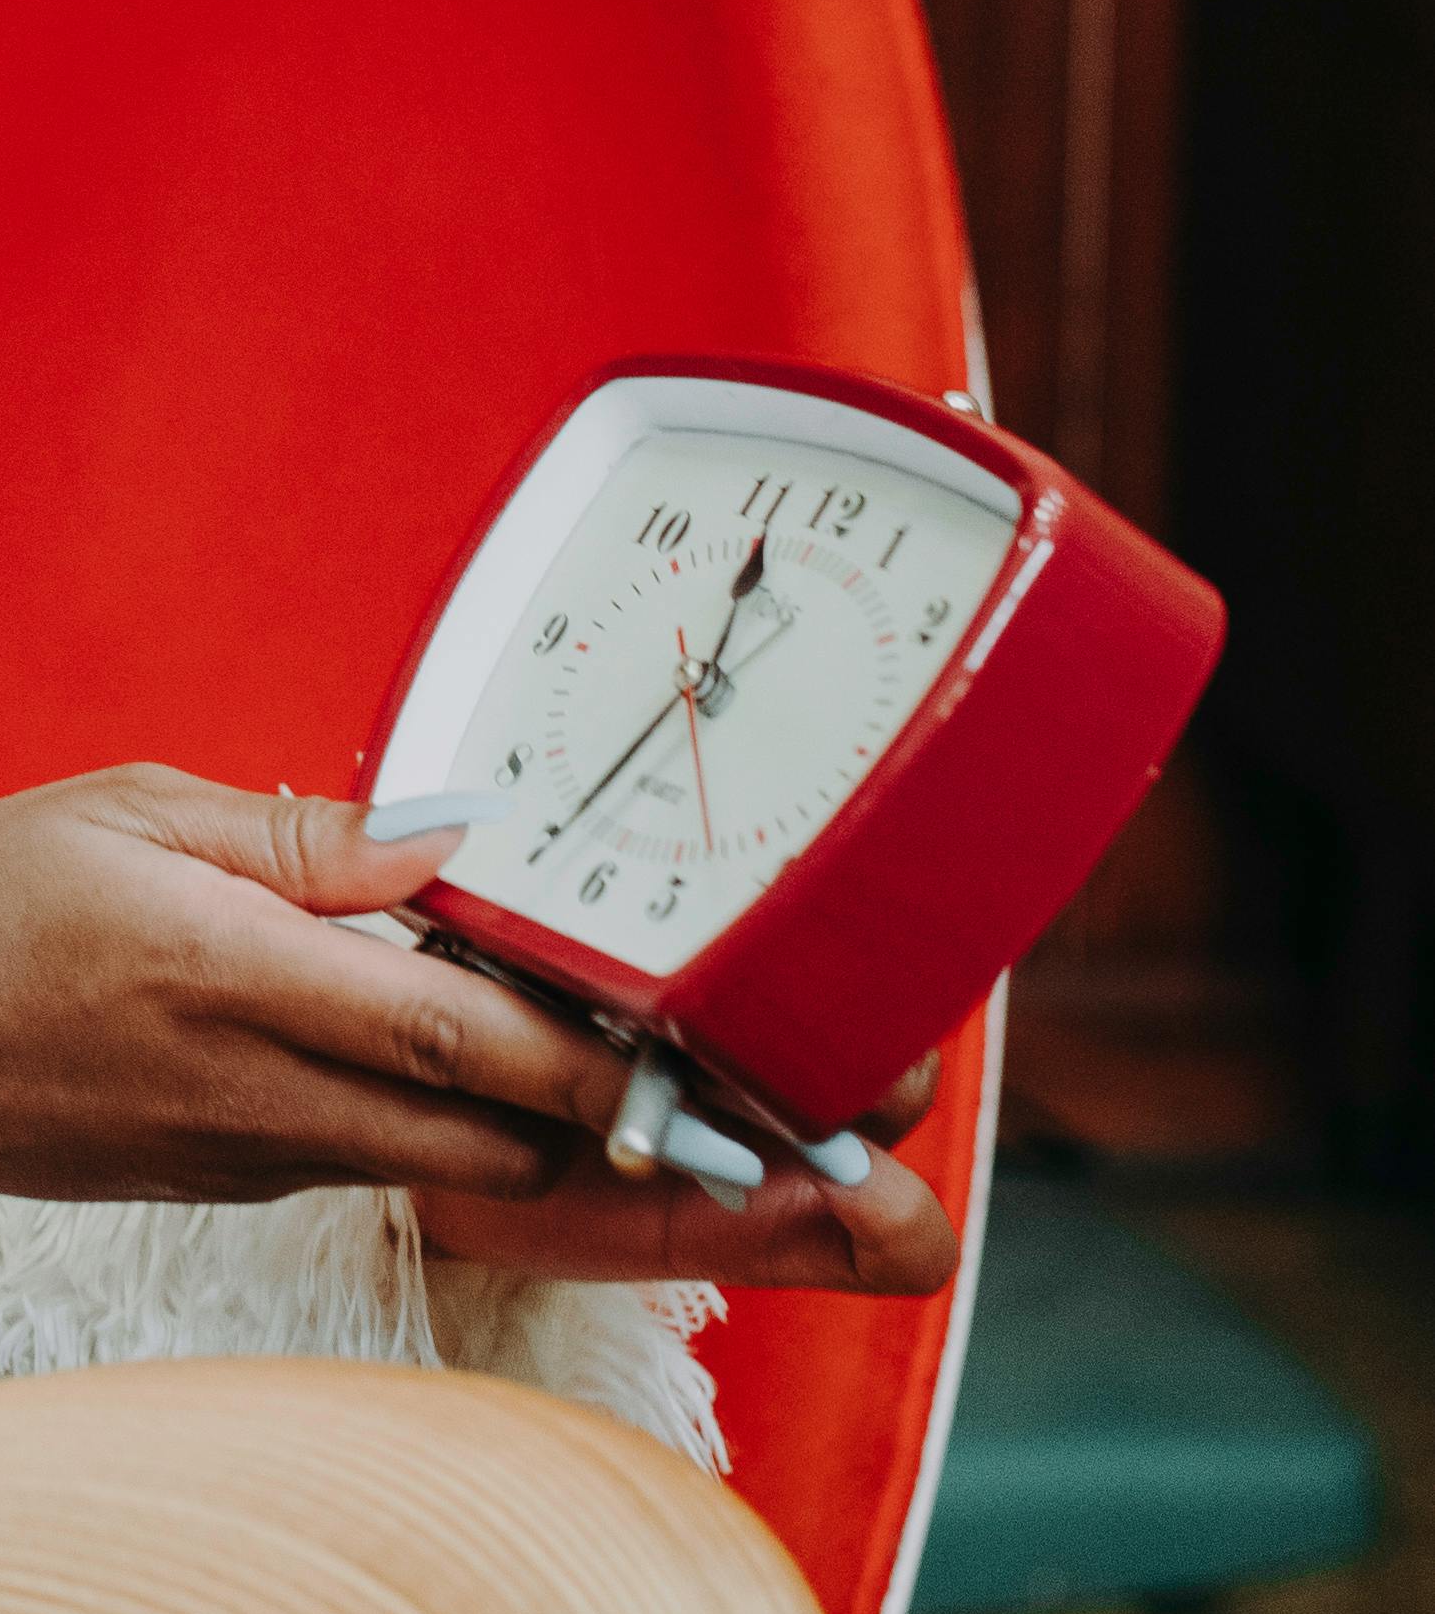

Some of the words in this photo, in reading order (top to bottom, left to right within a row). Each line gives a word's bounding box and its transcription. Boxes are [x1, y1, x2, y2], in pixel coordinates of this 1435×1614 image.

[740, 473, 793, 527] 11
[807, 484, 867, 539] 12
[635, 501, 692, 553] 10
[878, 523, 912, 570] 1
[532, 613, 569, 657] 9
[913, 597, 951, 646] 2
[494, 742, 533, 789] 8
[527, 820, 563, 866] 7
[578, 861, 618, 905] 6
[646, 874, 686, 921] 5
